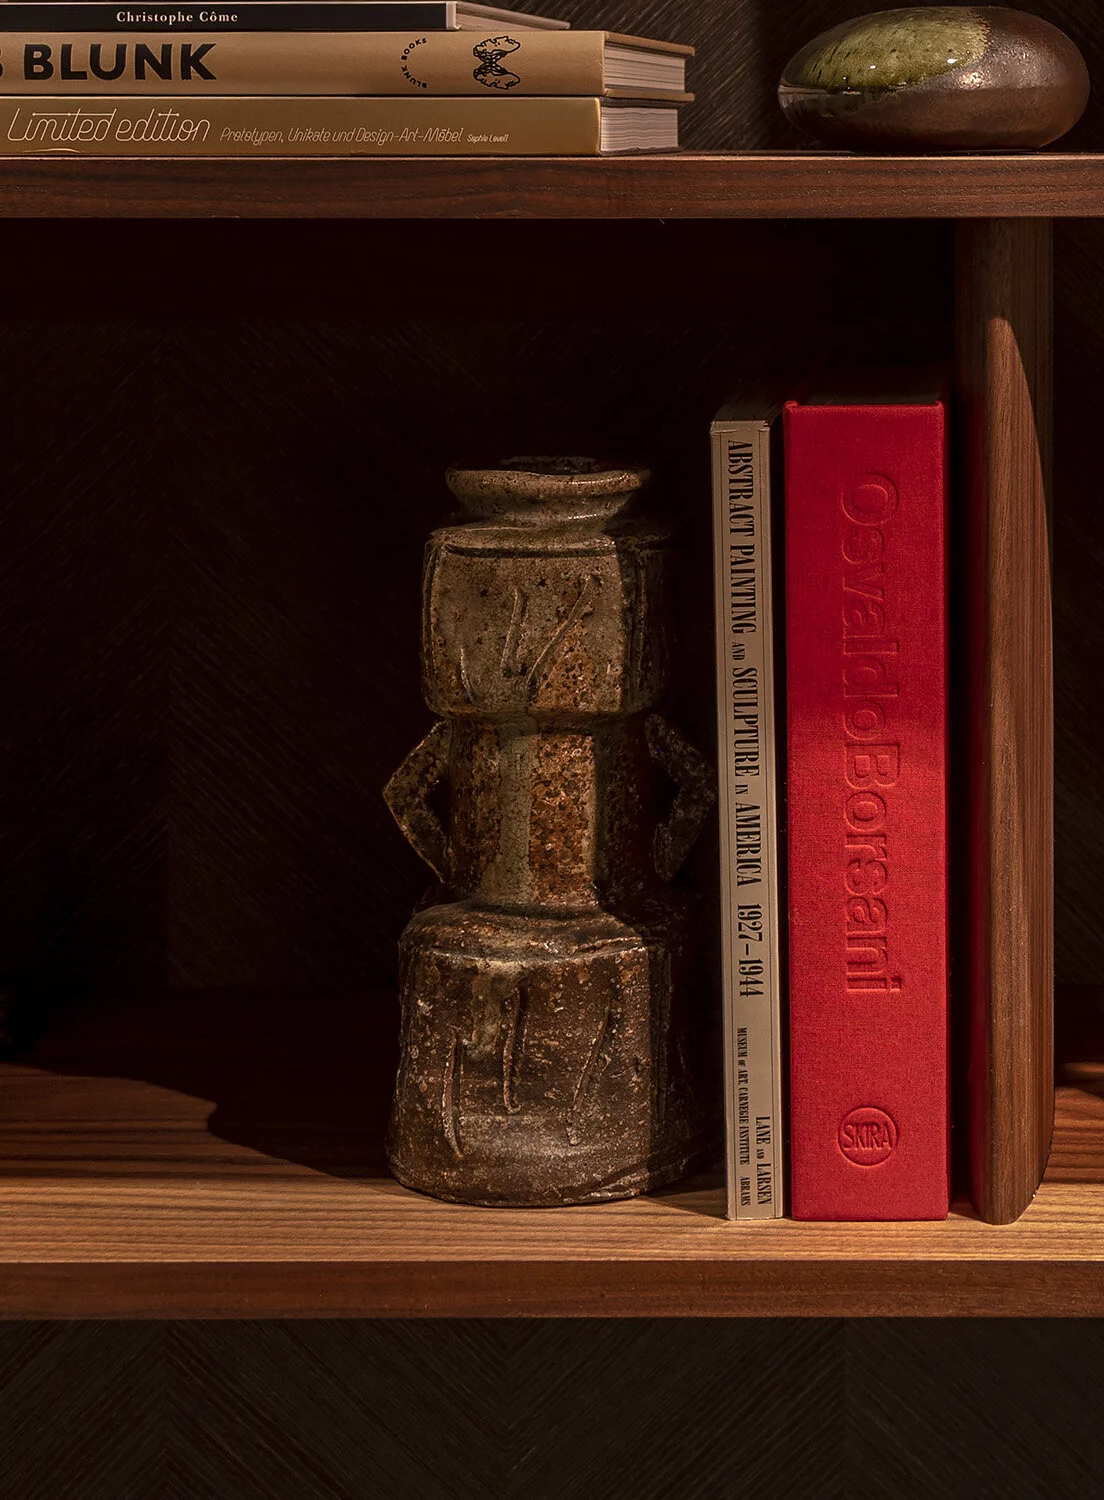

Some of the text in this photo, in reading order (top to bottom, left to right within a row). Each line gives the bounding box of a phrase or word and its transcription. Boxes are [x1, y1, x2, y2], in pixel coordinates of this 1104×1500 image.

[116, 9, 239, 26] Christophe Côme
[23, 42, 217, 82] BLUNK
[400, 37, 427, 89] BLUNK BOOKS
[7, 108, 211, 144] Limited edition
[220, 127, 284, 146] Prototypen,
[288, 127, 329, 142] Unikate
[333, 127, 356, 142] und
[727, 439, 755, 536] ABSTRACT
[729, 543, 758, 635] PAINTING
[731, 641, 747, 661] AND
[732, 667, 760, 778] SCULPTURE
[734, 784, 749, 795] IN
[734, 800, 763, 887] AMERICA
[737, 1027, 748, 1057] MUSEUM
[737, 1068, 749, 1085] ART,
[738, 1087, 750, 1124] CARNEGIE
[739, 1126, 751, 1165] INSTITUTE
[842, 1125, 894, 1150] SKIRA
[755, 1116, 773, 1205] LANE AND LARSEN
[740, 1176, 751, 1206] ABRAMS
